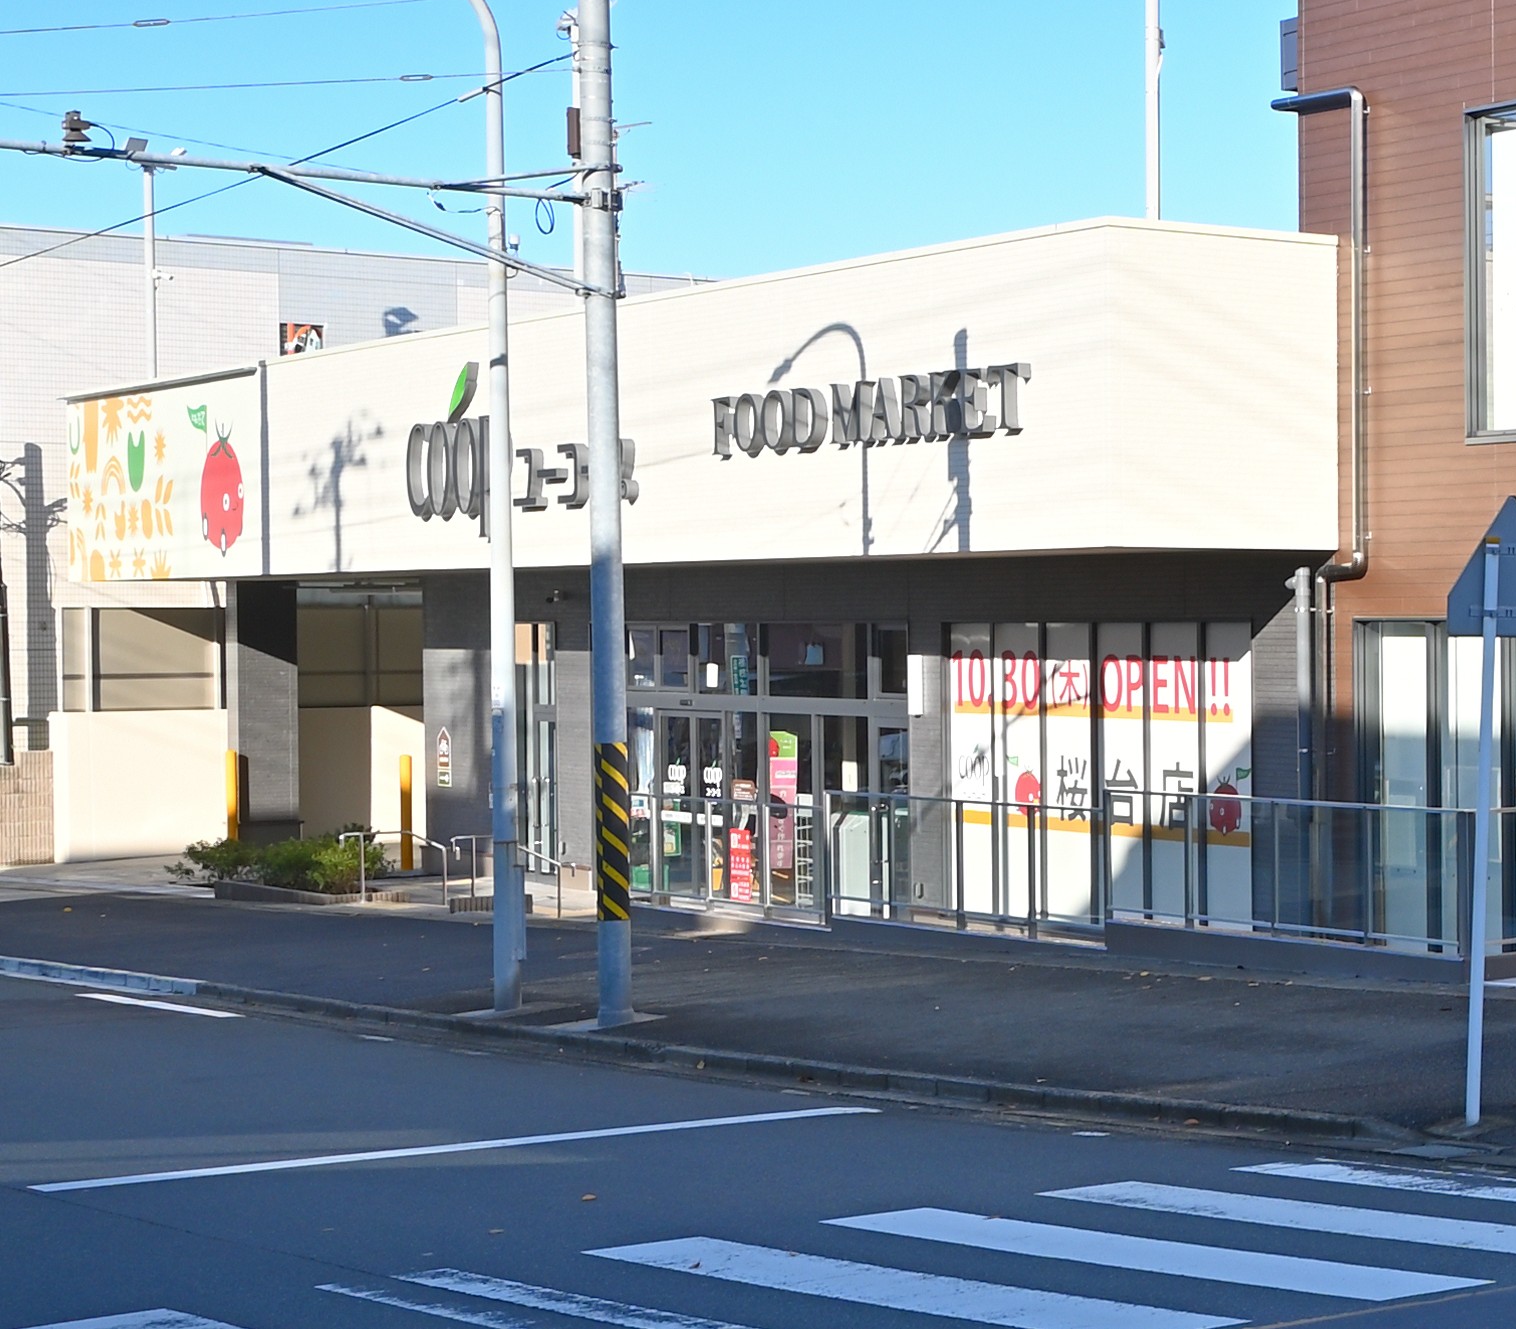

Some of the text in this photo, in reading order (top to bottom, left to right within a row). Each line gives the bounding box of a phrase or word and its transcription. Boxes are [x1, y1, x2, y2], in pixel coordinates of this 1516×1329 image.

[711, 362, 1032, 461] FOOD MARKET
[513, 438, 639, 512] ユーコ
[1056, 755, 1194, 830] 桜台店
